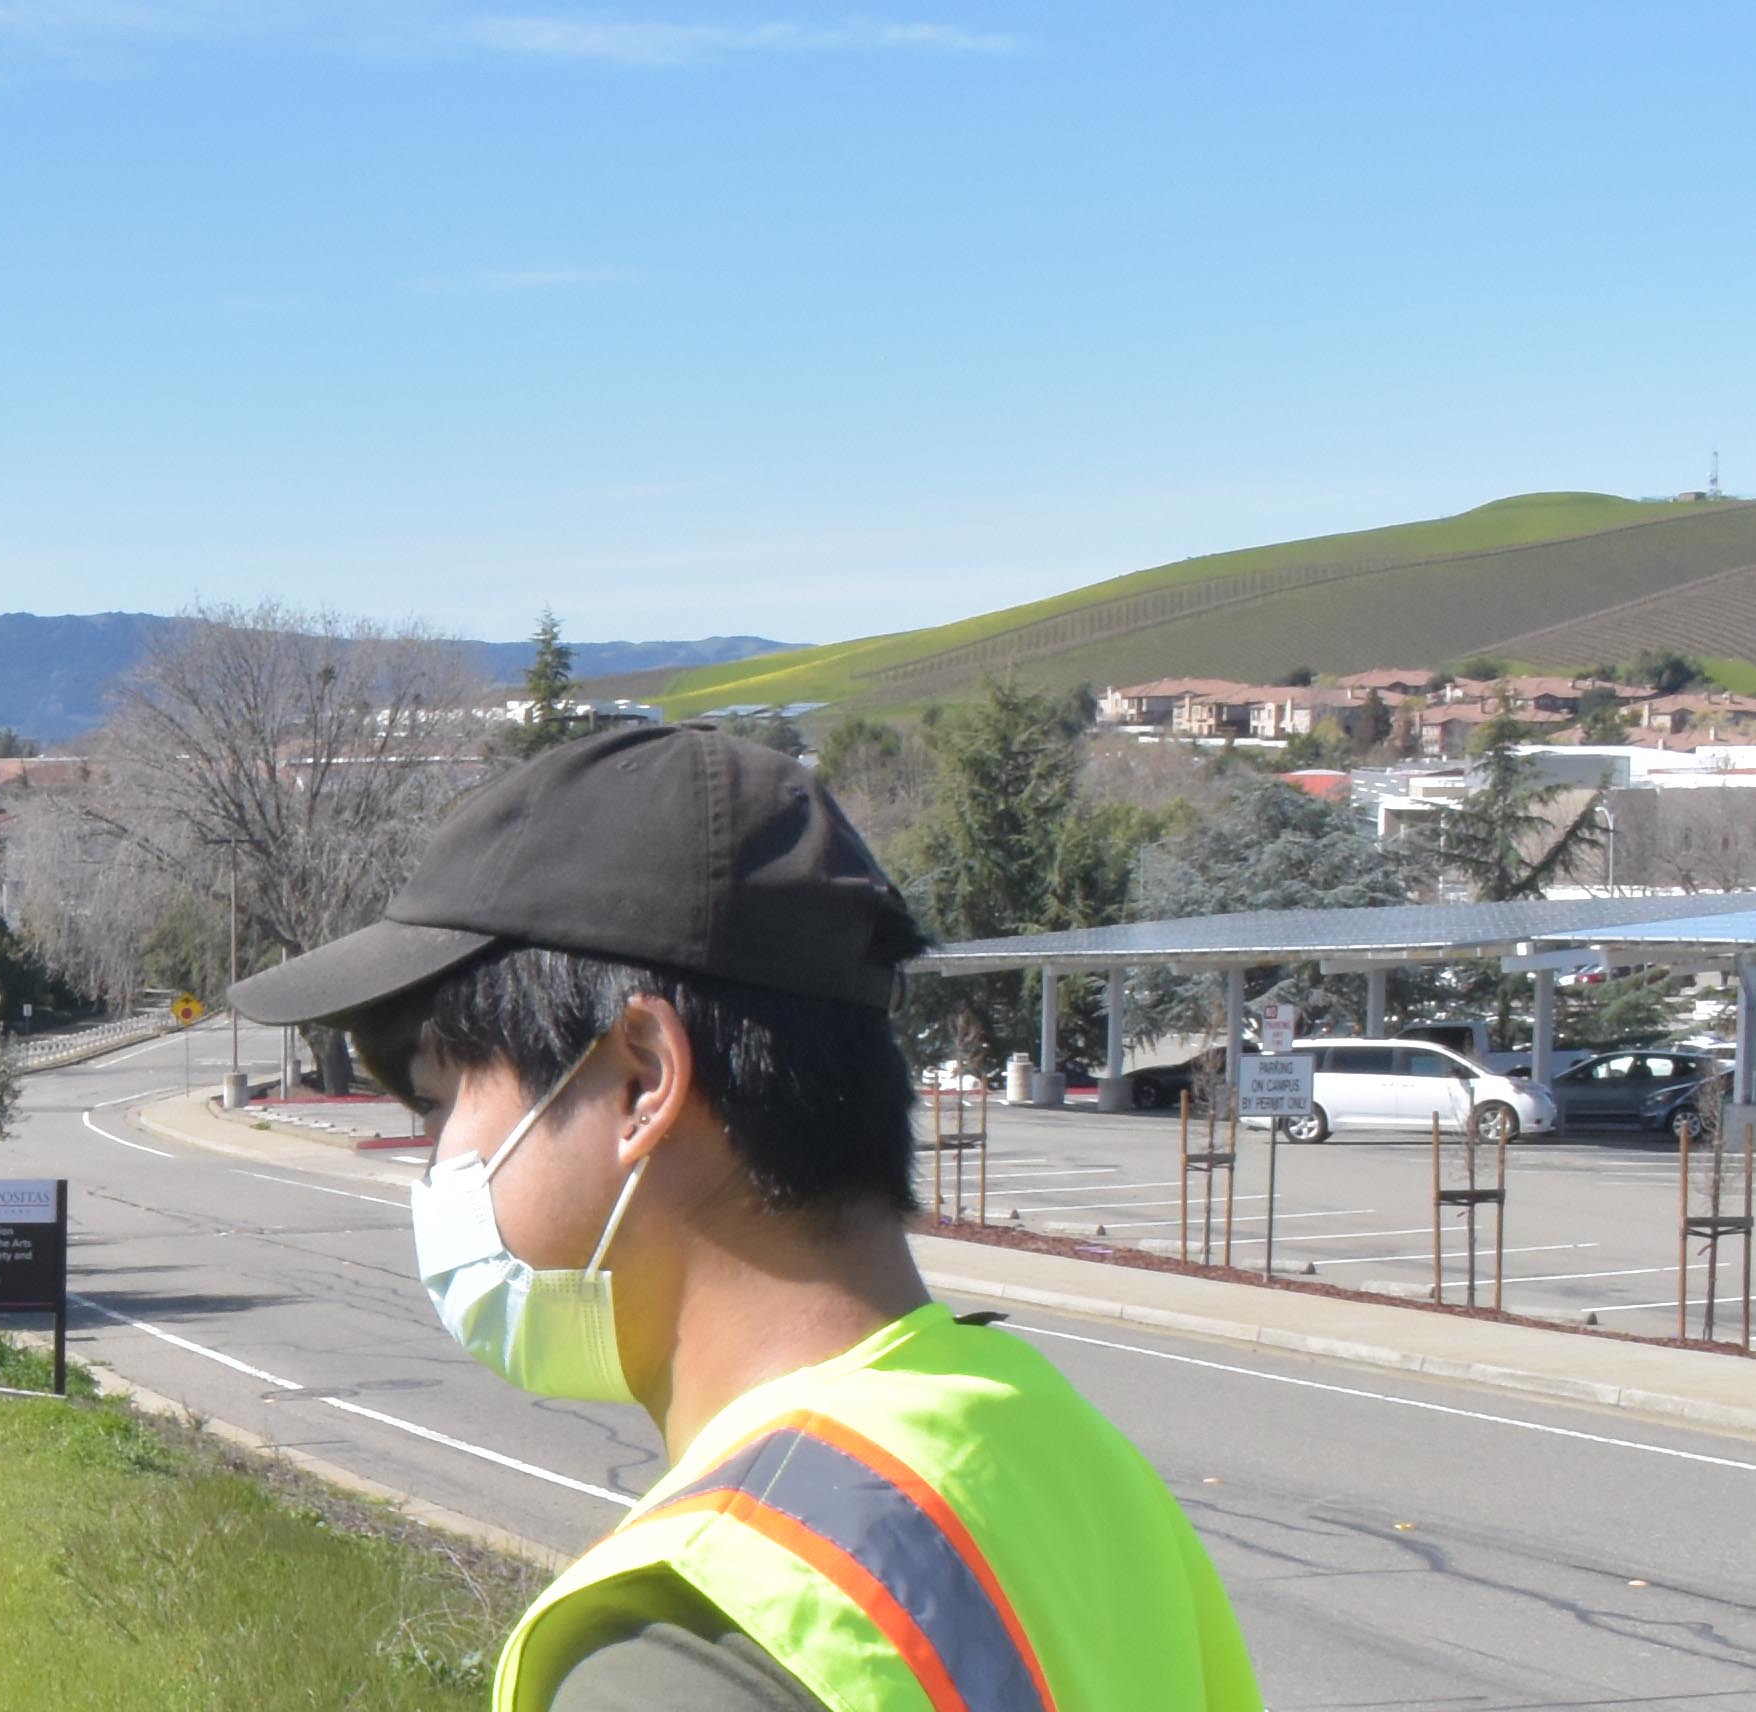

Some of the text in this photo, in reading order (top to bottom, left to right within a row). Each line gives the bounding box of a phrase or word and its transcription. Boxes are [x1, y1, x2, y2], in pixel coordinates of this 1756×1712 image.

[1251, 1080, 1300, 1092] ON CAMPUS
[1256, 1097, 1285, 1109] PERMIT
[12, 1239, 33, 1248] Arts
[14, 1251, 32, 1260] and
